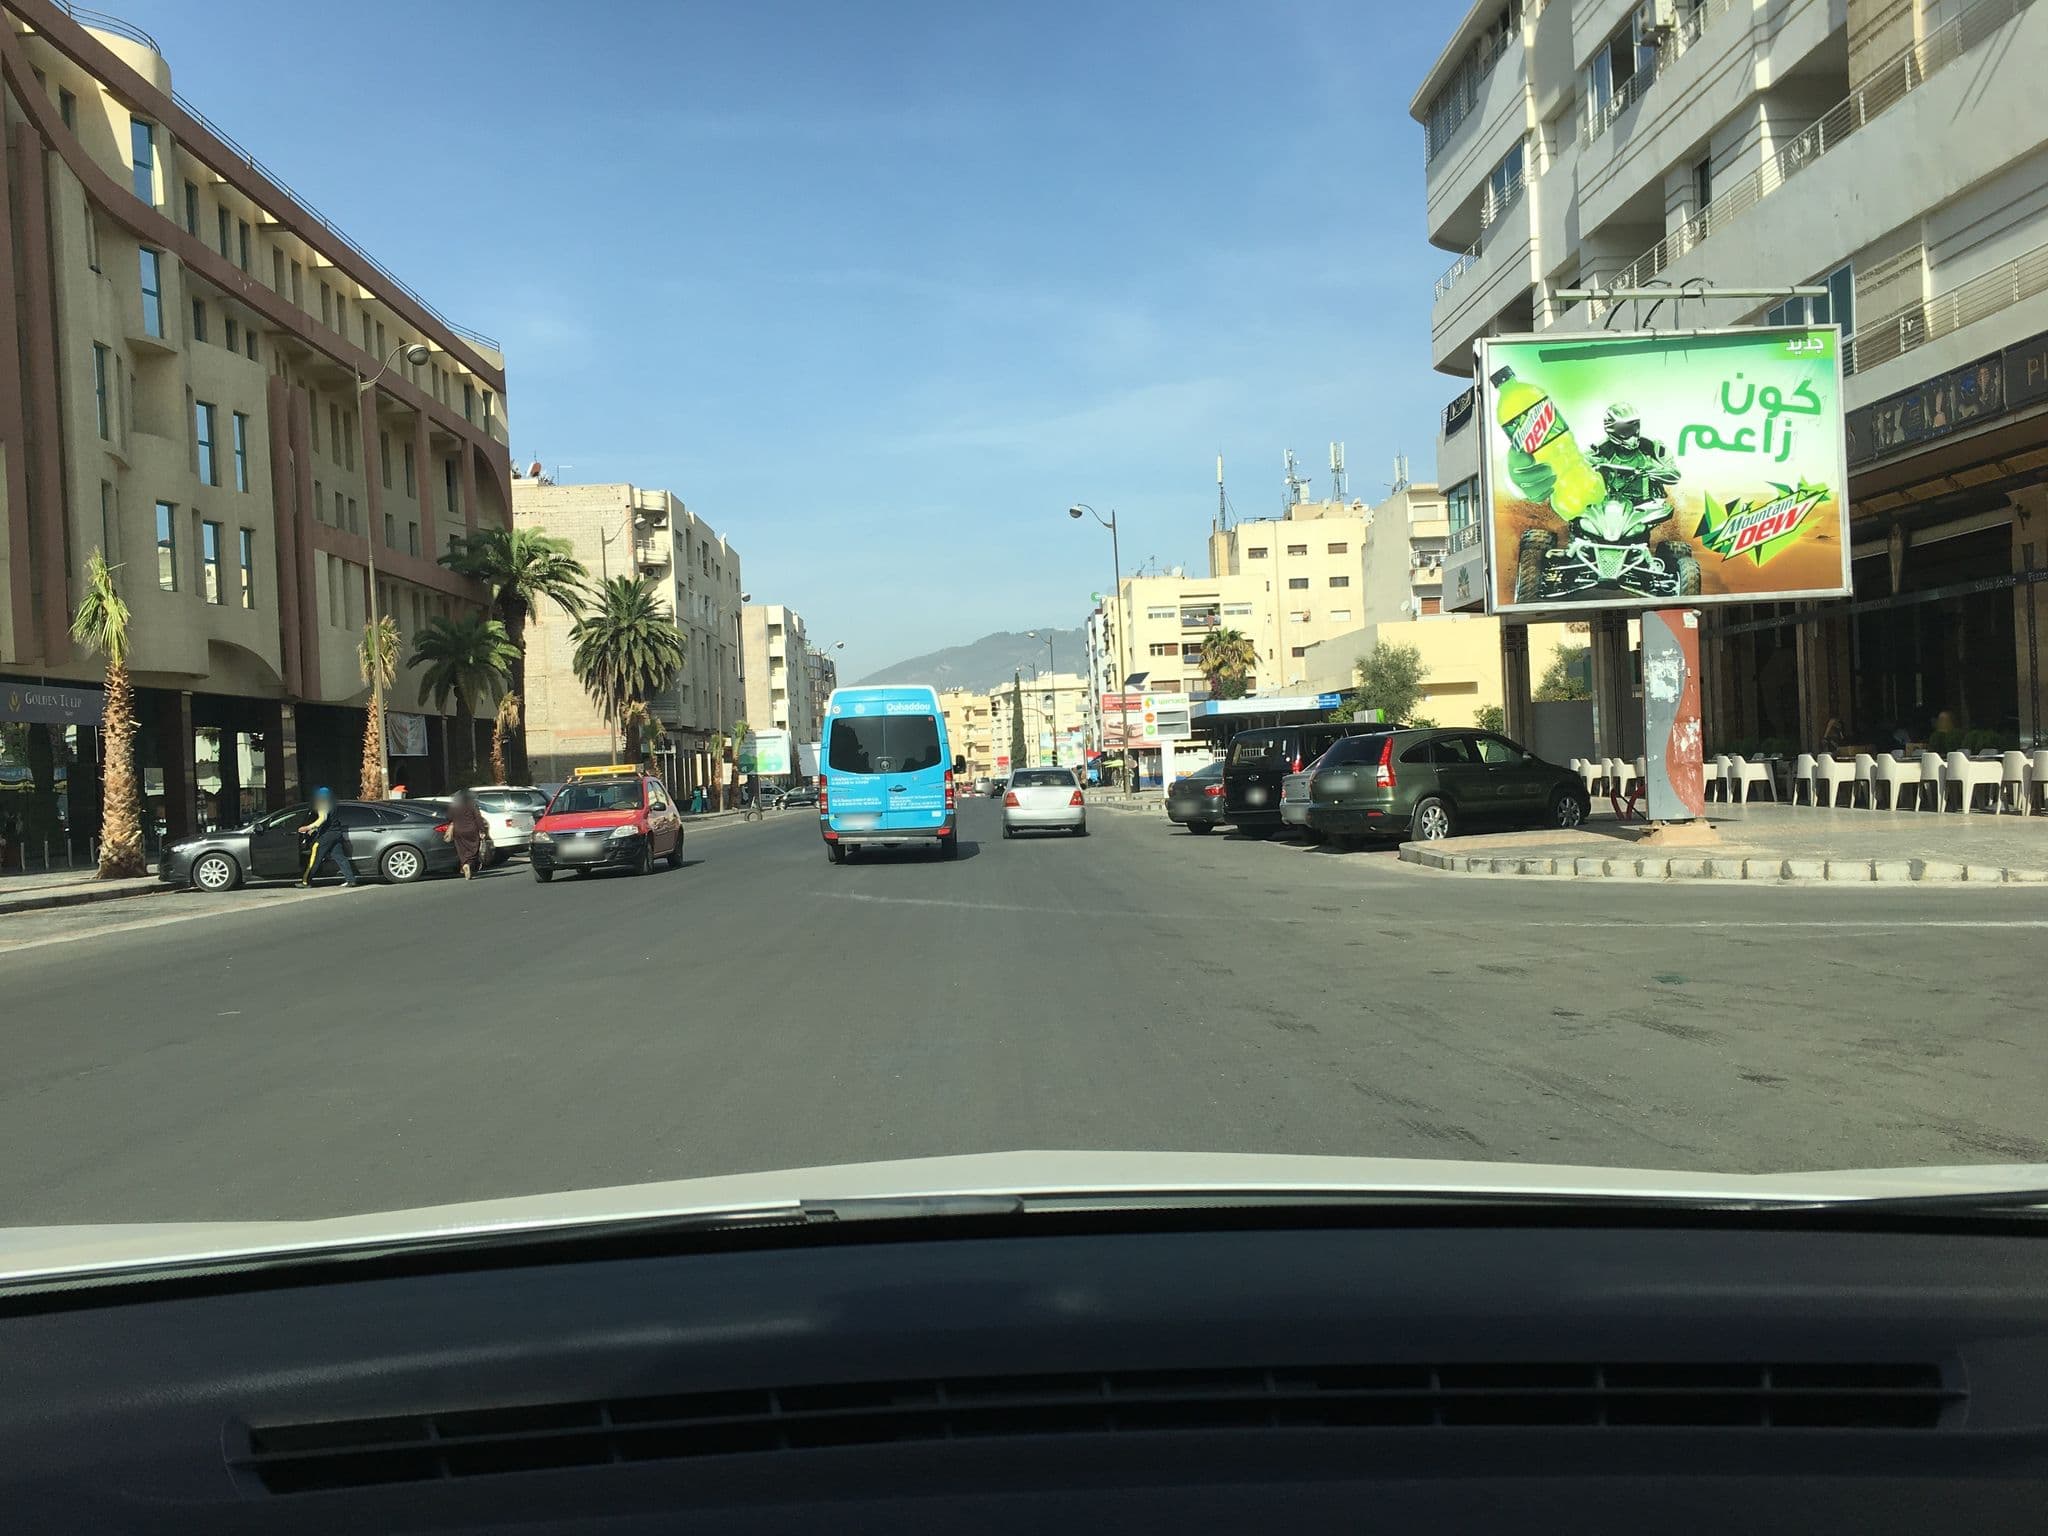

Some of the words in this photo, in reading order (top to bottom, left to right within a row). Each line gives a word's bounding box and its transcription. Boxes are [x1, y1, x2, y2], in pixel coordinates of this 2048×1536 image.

[1786, 337, 1824, 354] جديد
[1721, 372, 1822, 418] كون
[1677, 418, 1792, 463] زاعم
[1723, 498, 1795, 537] Mountain
